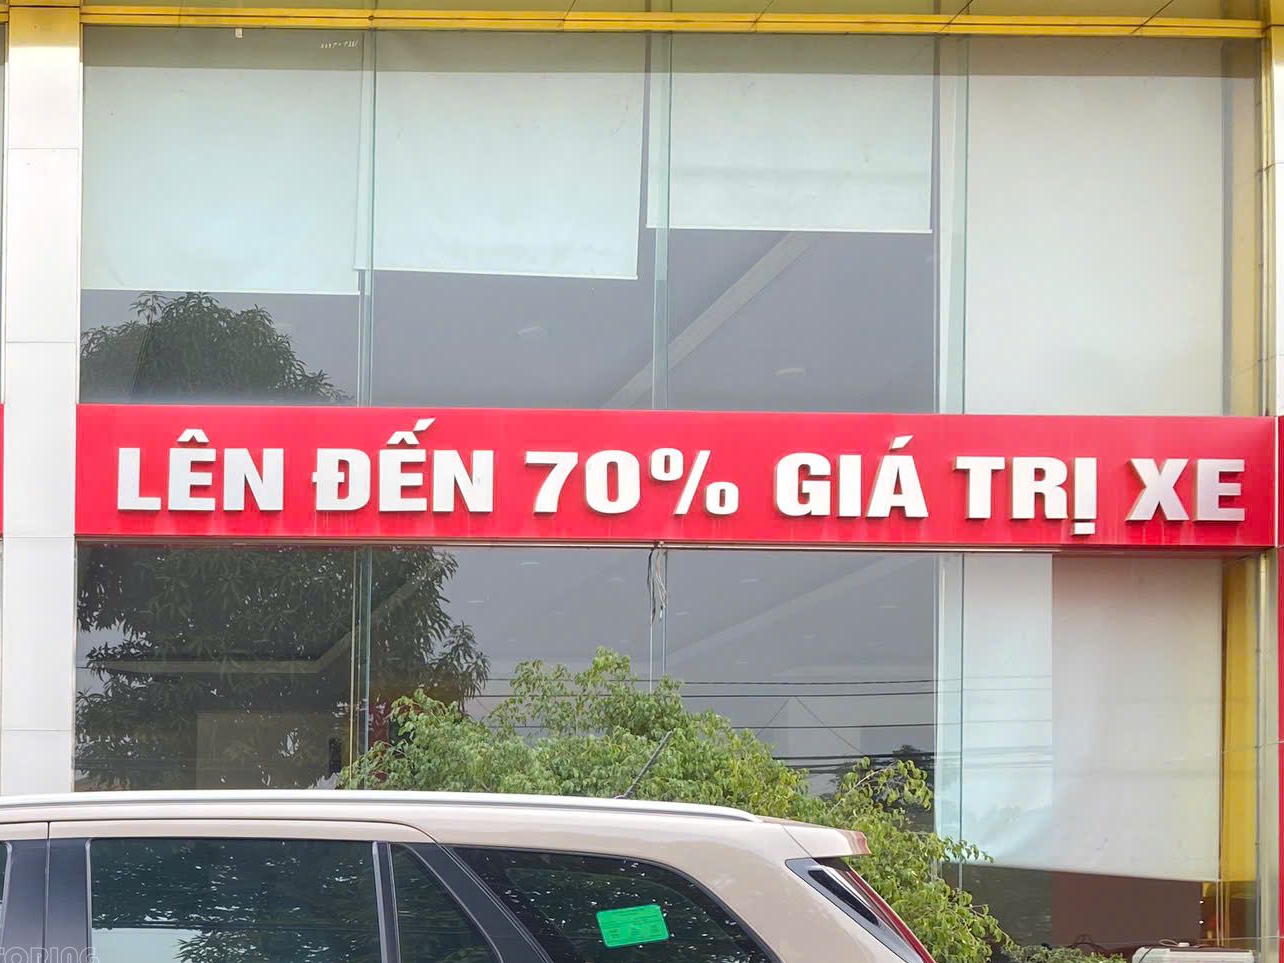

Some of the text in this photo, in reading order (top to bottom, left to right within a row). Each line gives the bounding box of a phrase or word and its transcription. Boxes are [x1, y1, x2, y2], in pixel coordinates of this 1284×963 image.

[117, 418, 1246, 536] LÊN ĐẾN 70% GIÁ TRỊ XE
